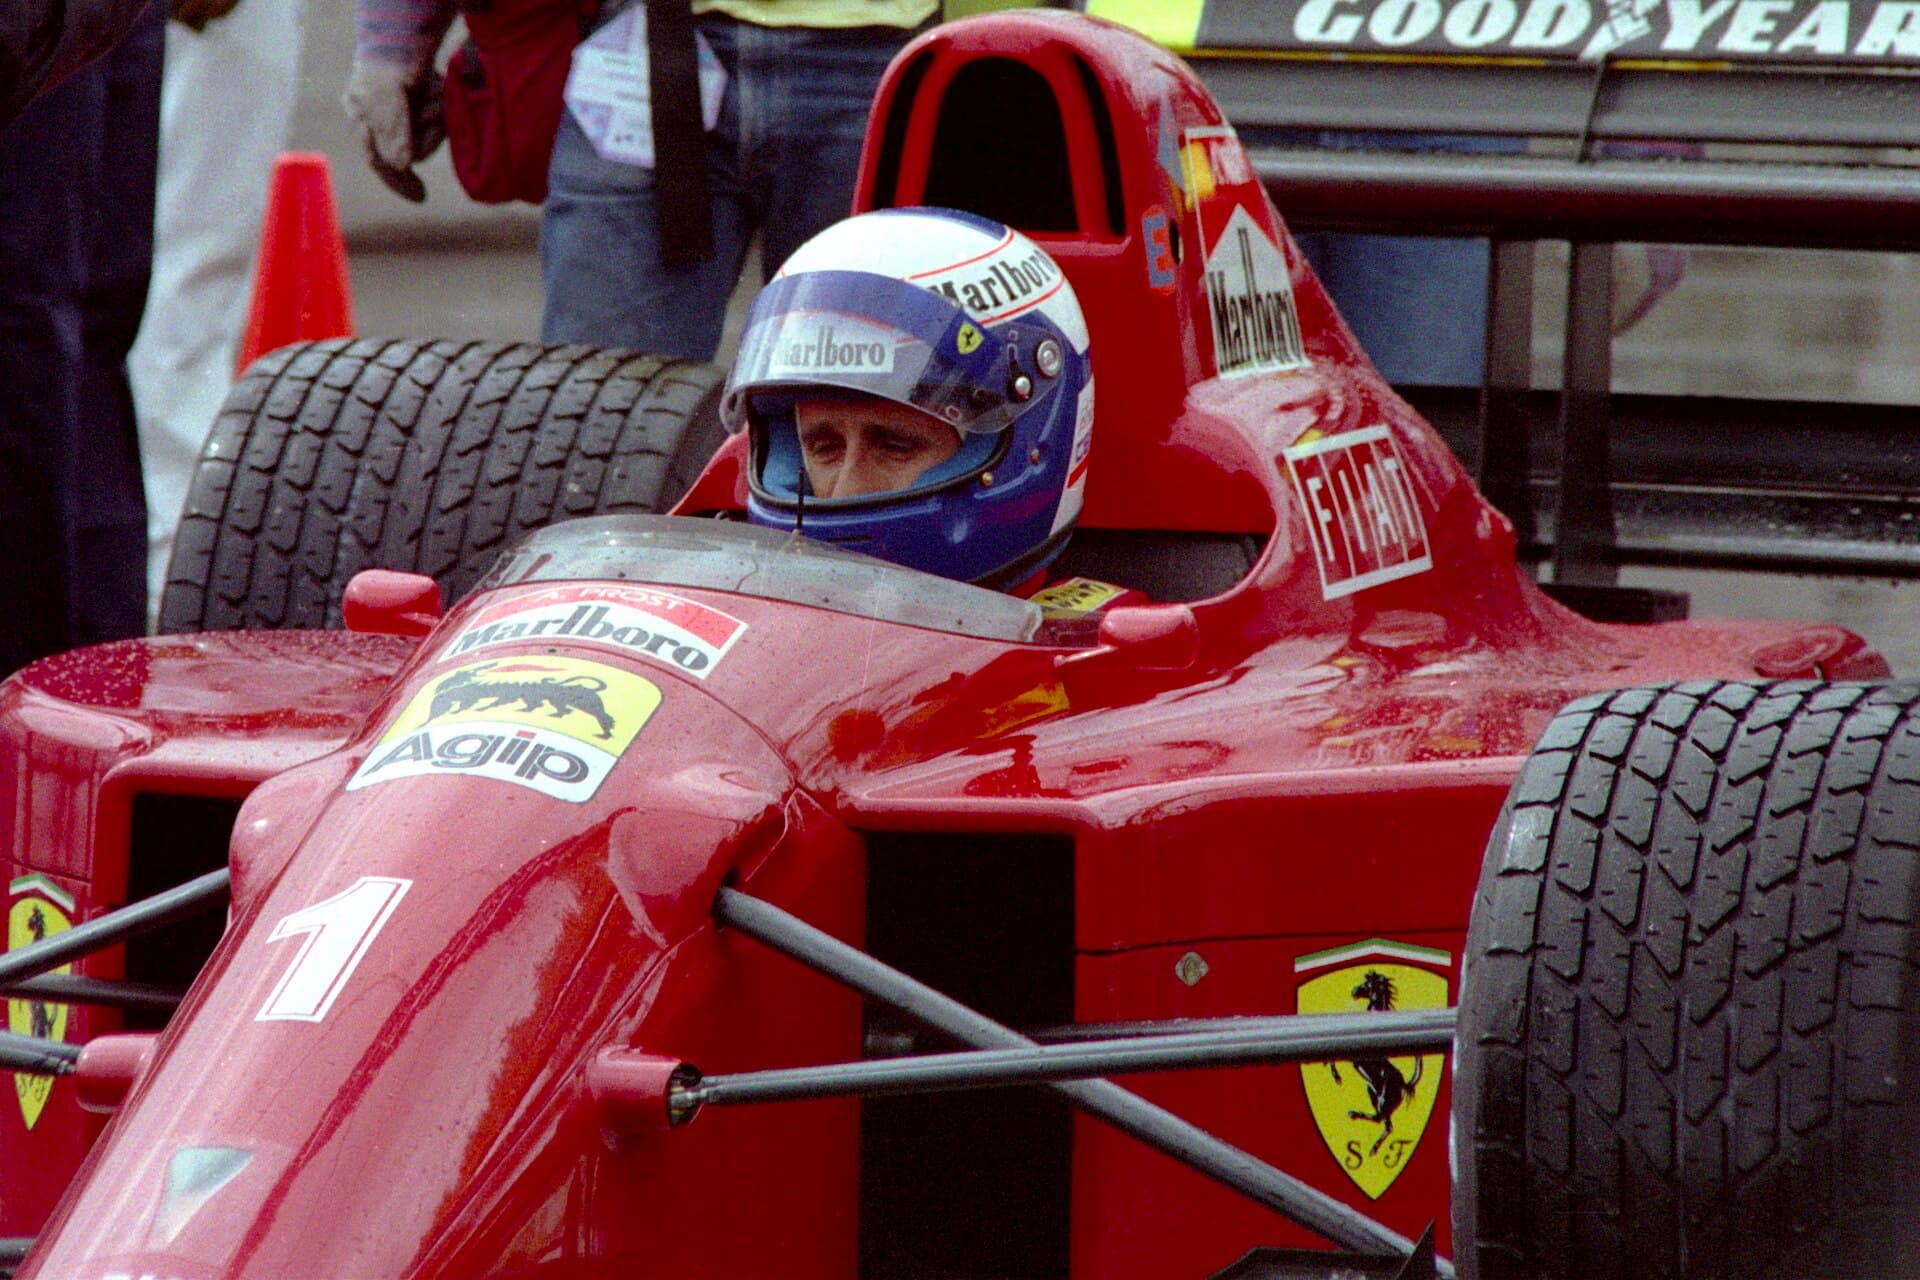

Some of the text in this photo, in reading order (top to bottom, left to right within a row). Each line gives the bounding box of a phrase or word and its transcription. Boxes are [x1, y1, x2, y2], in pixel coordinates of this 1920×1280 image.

[1293, 0, 1920, 56] GOOD YEAR
[1142, 213, 1174, 288] E
[1207, 227, 1305, 373] Marlboro
[777, 325, 886, 367] arlboro
[1306, 458, 1417, 562] FIAT
[579, 587, 684, 610] PROST
[449, 605, 711, 675] Marlboro
[361, 729, 590, 785] Agip
[254, 876, 413, 1023] 1
[1345, 1139, 1414, 1170] S F
